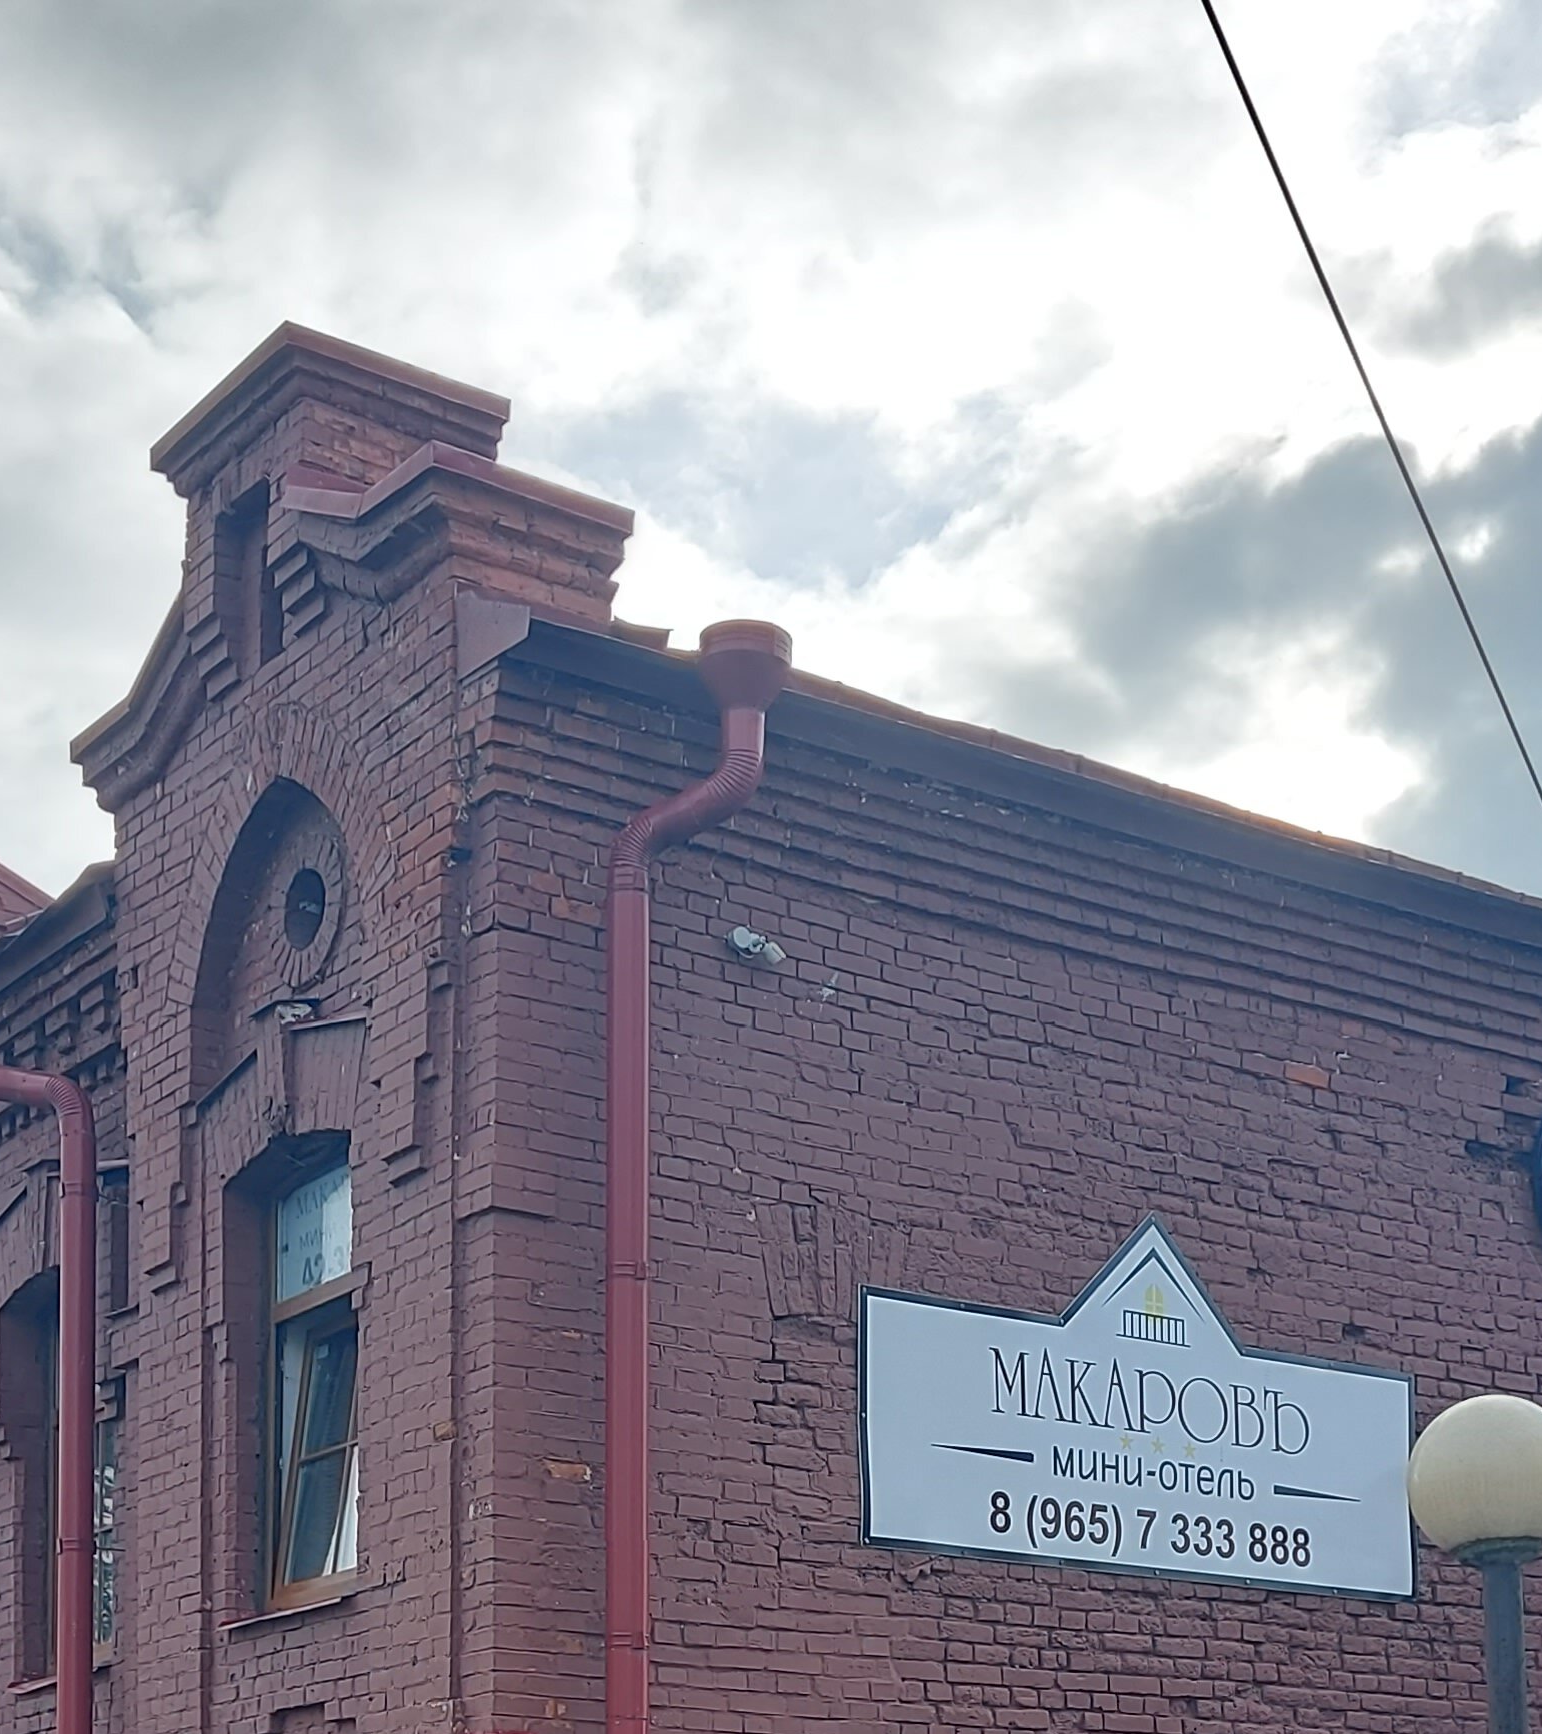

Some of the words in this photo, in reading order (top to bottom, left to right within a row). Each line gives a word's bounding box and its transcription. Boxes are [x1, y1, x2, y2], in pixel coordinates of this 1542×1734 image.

[989, 1346, 1310, 1456] МАКАРОВЪ
[1052, 1445, 1256, 1501] мини-отель
[989, 1491, 1012, 1534] 8
[1026, 1495, 1124, 1557] (965)
[1136, 1509, 1158, 1549] 7
[1170, 1513, 1235, 1559] 333
[1248, 1522, 1311, 1567] 888
